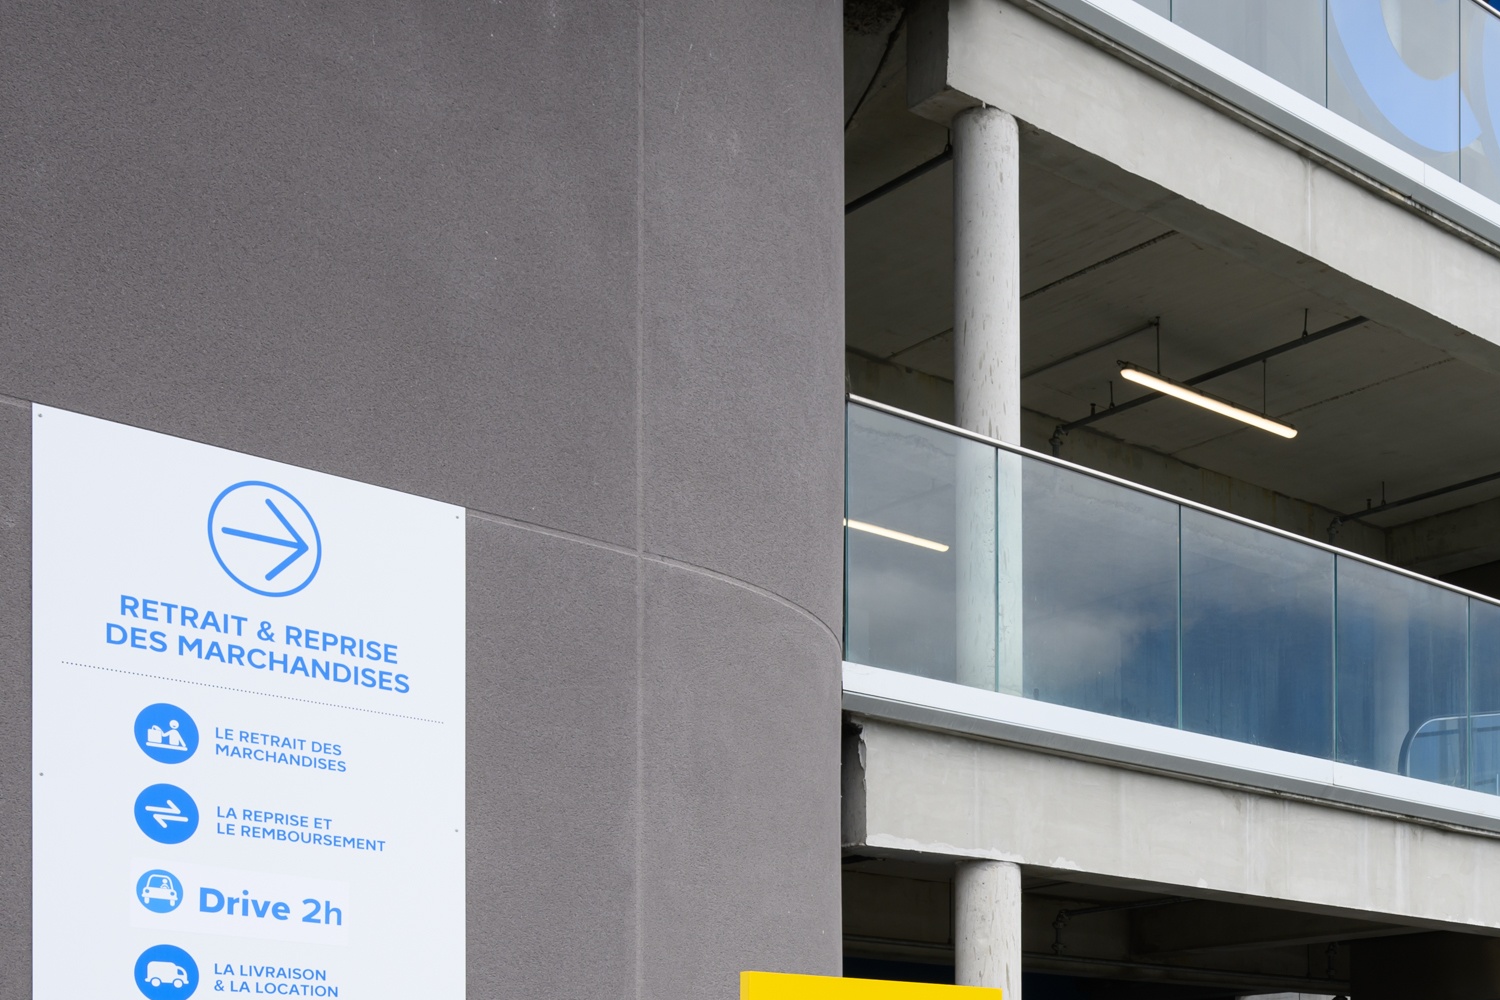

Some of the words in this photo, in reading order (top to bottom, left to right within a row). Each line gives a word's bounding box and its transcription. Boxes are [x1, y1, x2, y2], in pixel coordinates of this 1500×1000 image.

[120, 594, 248, 637] RETRAIT
[256, 620, 276, 643] &
[285, 625, 399, 665] REPRISE
[106, 622, 168, 653] DES
[178, 638, 410, 694] MARCHANDISES
[215, 727, 234, 742] LE
[239, 730, 307, 751] RETRAIT
[311, 739, 343, 756] DES
[215, 743, 347, 773] MARCHANDISES
[216, 805, 238, 820] LA
[243, 808, 309, 828] REPRISE
[314, 817, 333, 830] ET
[216, 822, 236, 835] LE
[240, 825, 386, 852] REMBOURSEMENT
[199, 886, 291, 921] Drive
[301, 898, 343, 926] 2h
[214, 963, 235, 976] LA
[239, 965, 327, 981] LIVRAISON
[214, 979, 225, 992] &
[229, 980, 250, 993] LA
[255, 981, 339, 998] LOCATION
